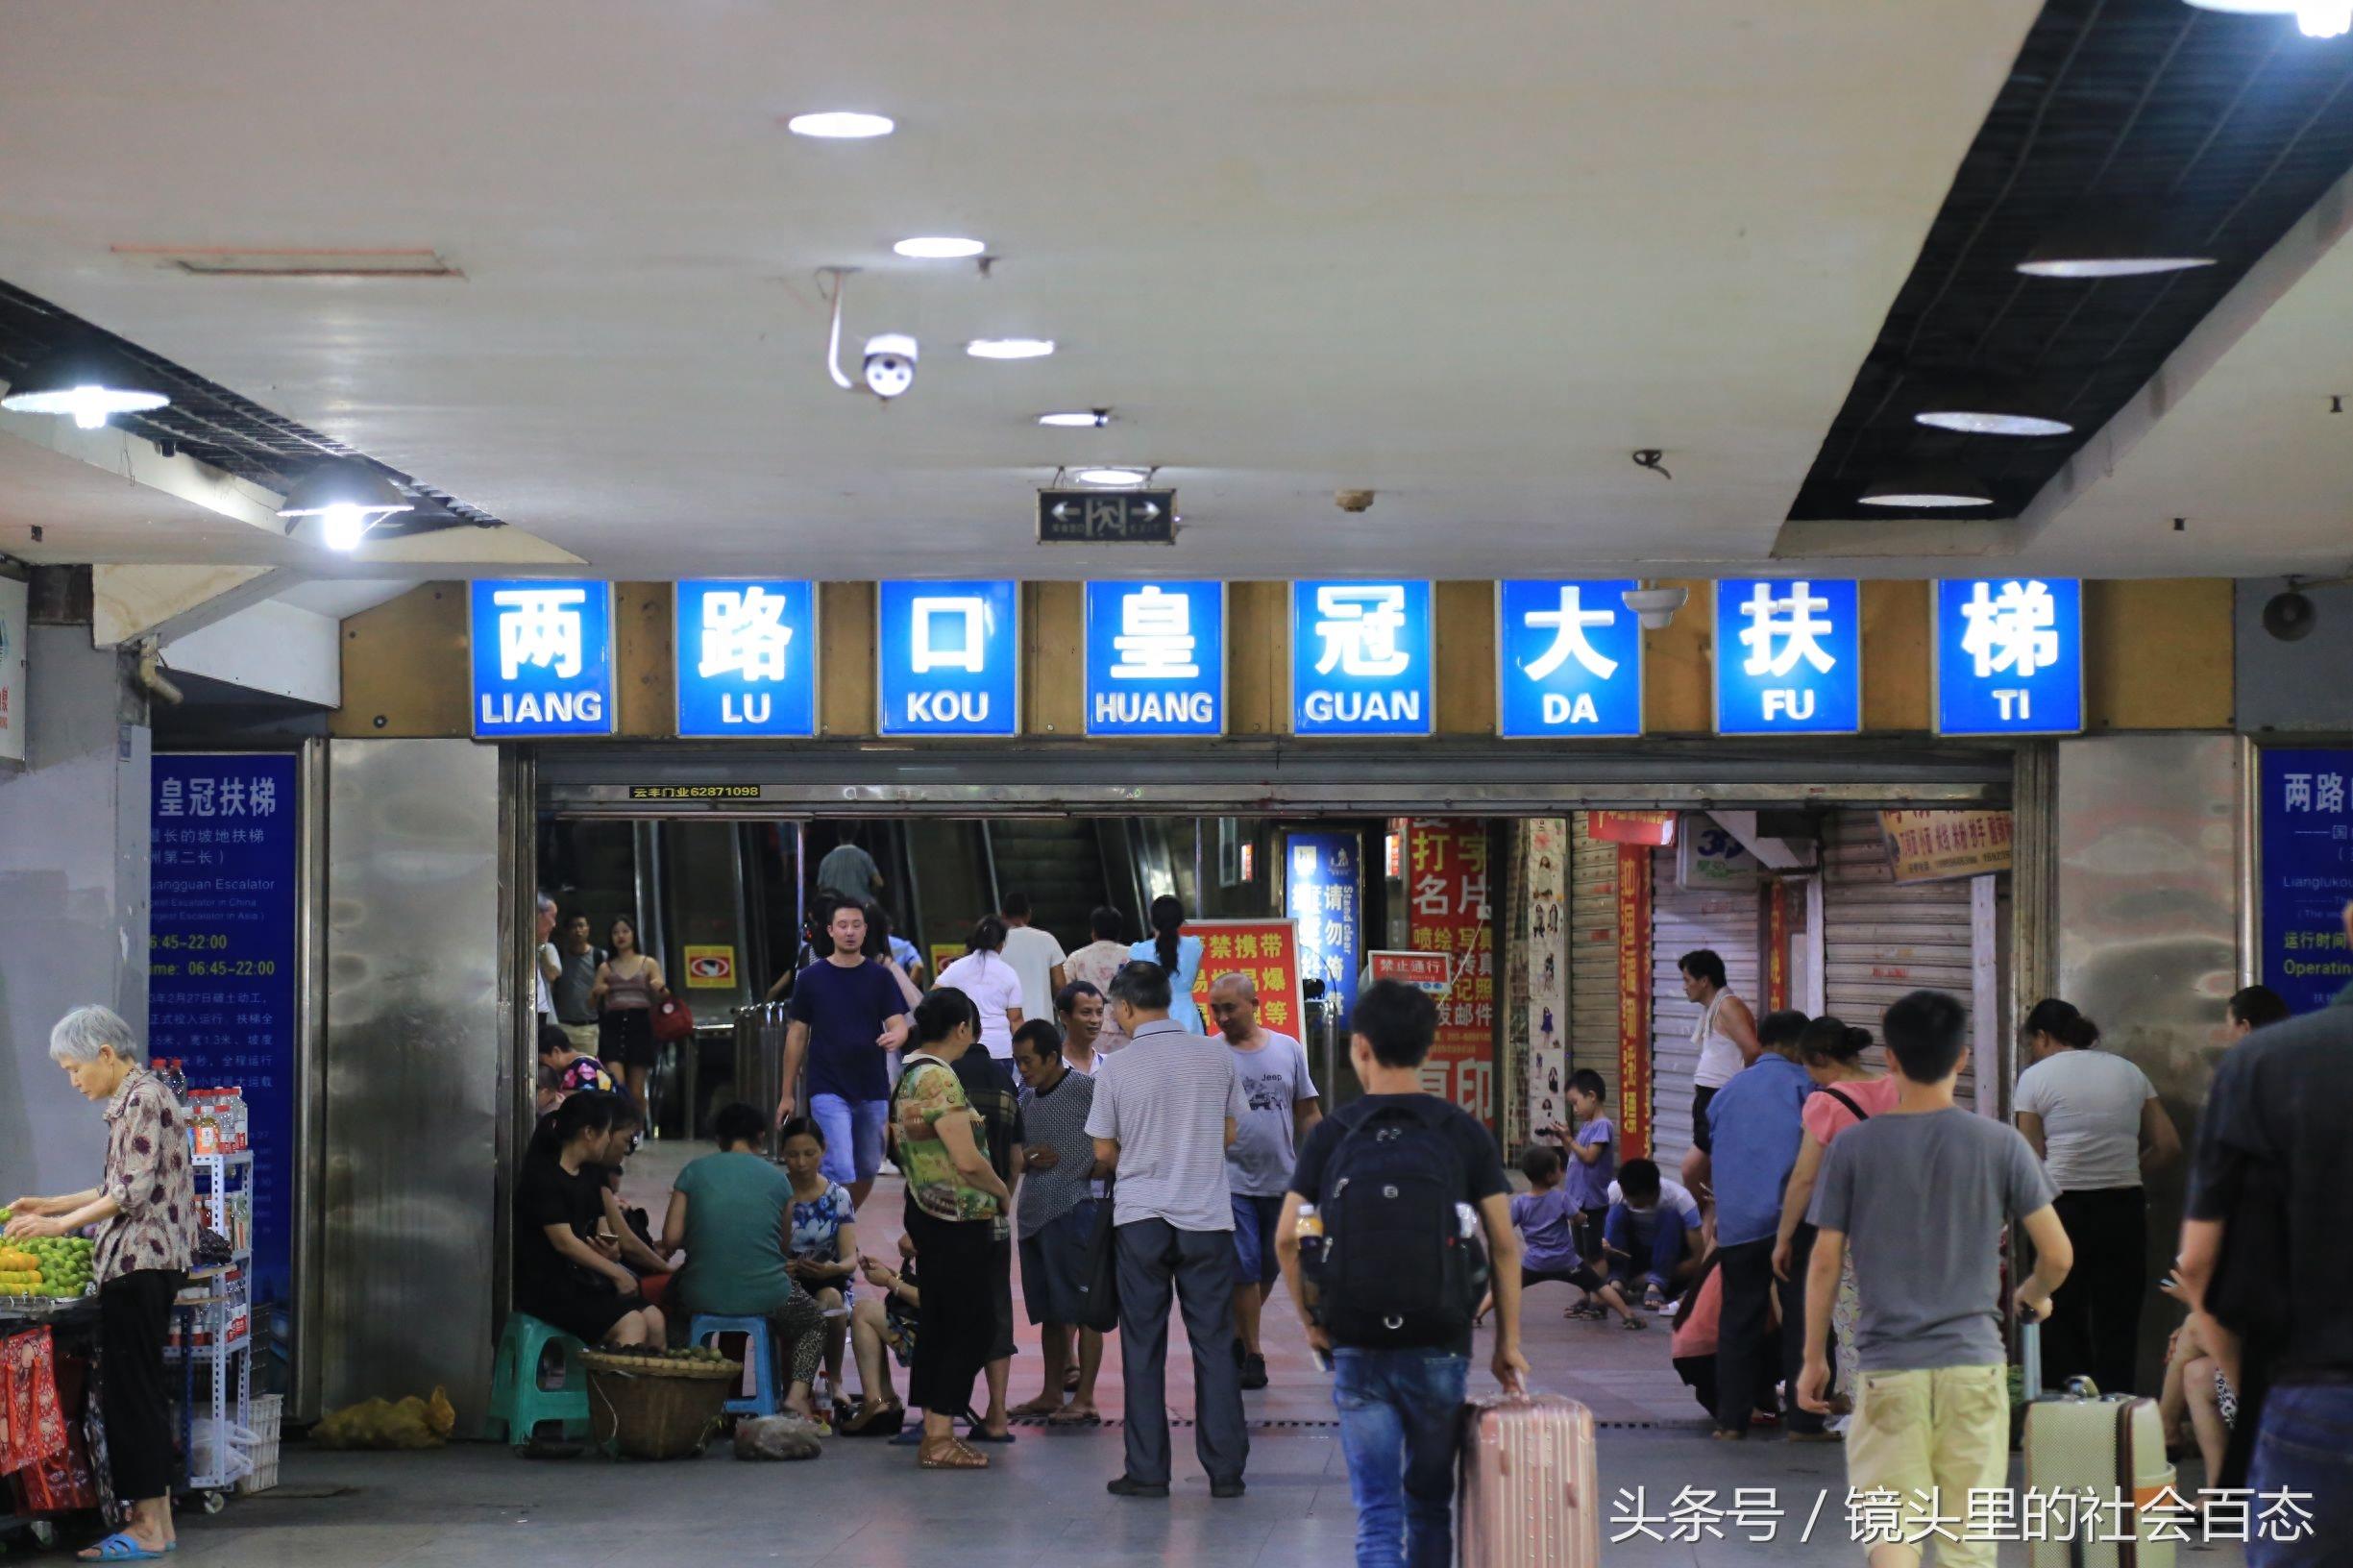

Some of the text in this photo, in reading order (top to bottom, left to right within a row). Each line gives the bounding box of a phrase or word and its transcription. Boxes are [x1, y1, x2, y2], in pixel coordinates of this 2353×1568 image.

[493, 579, 2059, 680] 两 路 口 皇 冠 大 扶 梯
[481, 688, 2030, 724] LIANG LU KOU HUANG GUAN DA FU TI
[158, 776, 277, 817] 皇冠扶梯
[2284, 772, 2353, 813] 两路
[215, 877, 276, 891] Escalator
[1412, 873, 1487, 916] 名片
[1200, 933, 1284, 959] 禁携带
[2283, 932, 2346, 950] 运行时间
[1380, 959, 1441, 974] 禁止通行
[2283, 959, 2353, 977] Operatin
[1262, 1073, 1282, 1083] Jeep
